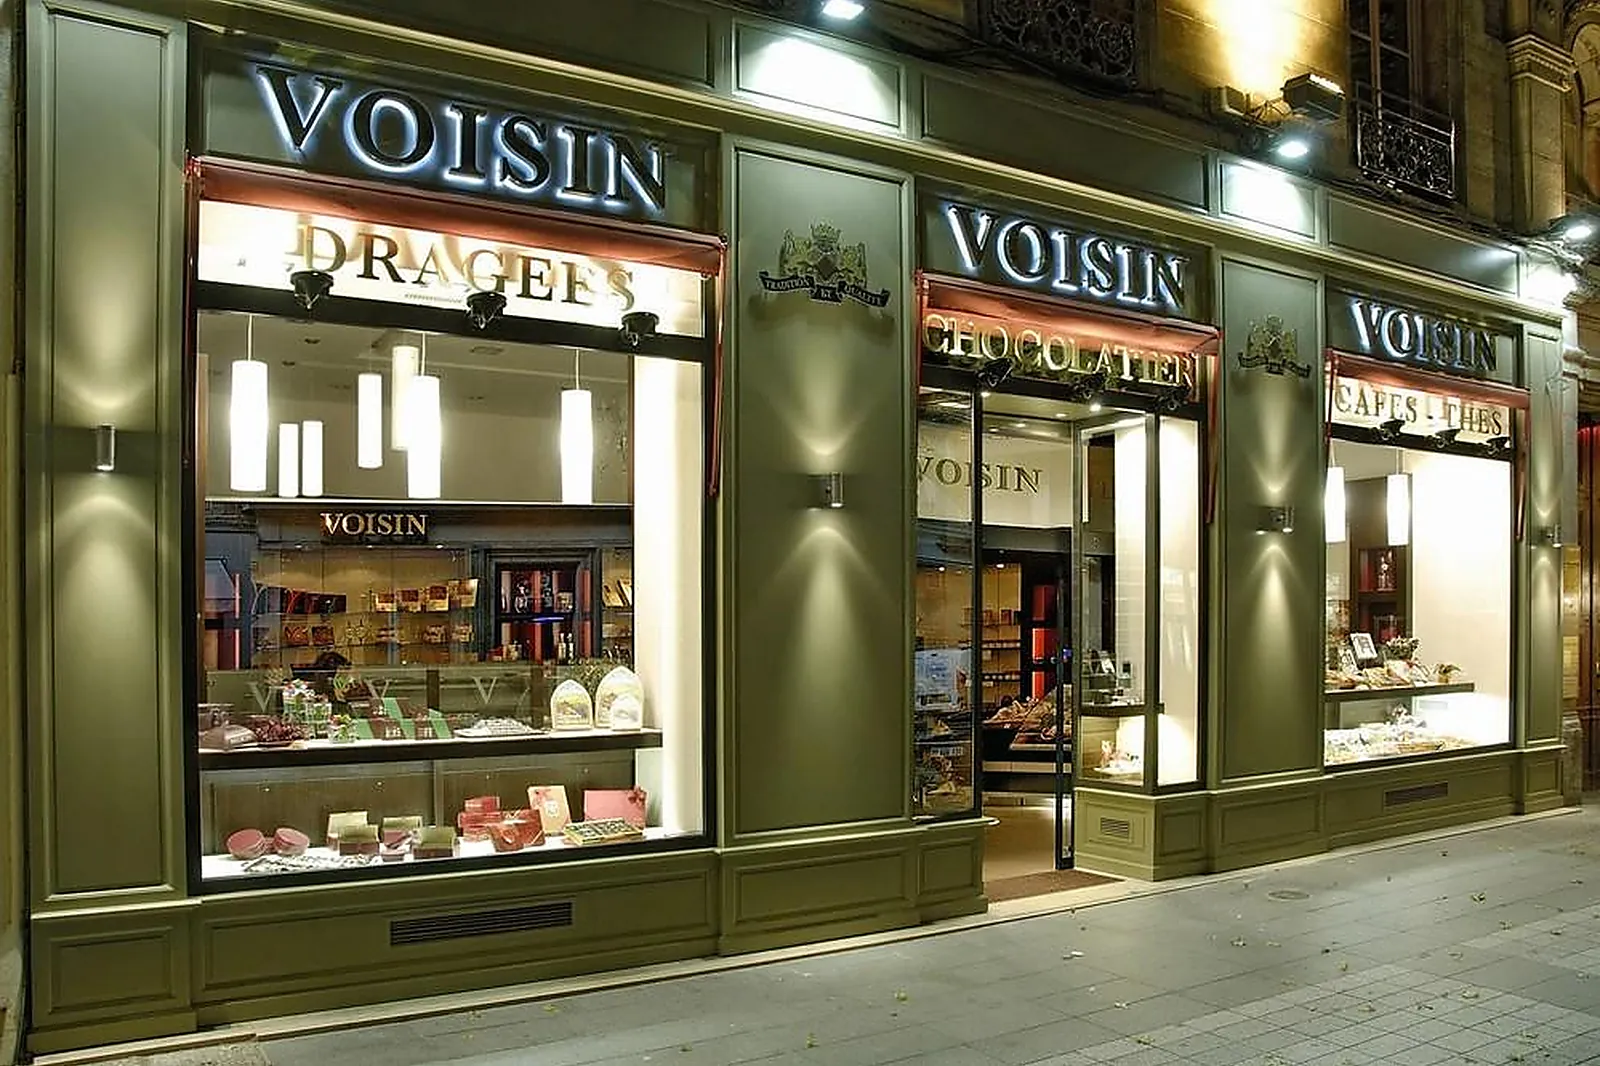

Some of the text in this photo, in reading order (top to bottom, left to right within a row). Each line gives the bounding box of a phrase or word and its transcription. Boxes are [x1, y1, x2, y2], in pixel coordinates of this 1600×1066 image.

[254, 64, 669, 213] VOISIN
[944, 203, 1188, 310] VOISIN
[923, 313, 1193, 388] CHOCOLATIER
[1350, 299, 1499, 371] VOISIN
[1334, 384, 1417, 423] CAFES
[1444, 402, 1502, 435] THES
[320, 512, 428, 535] VOISIN
